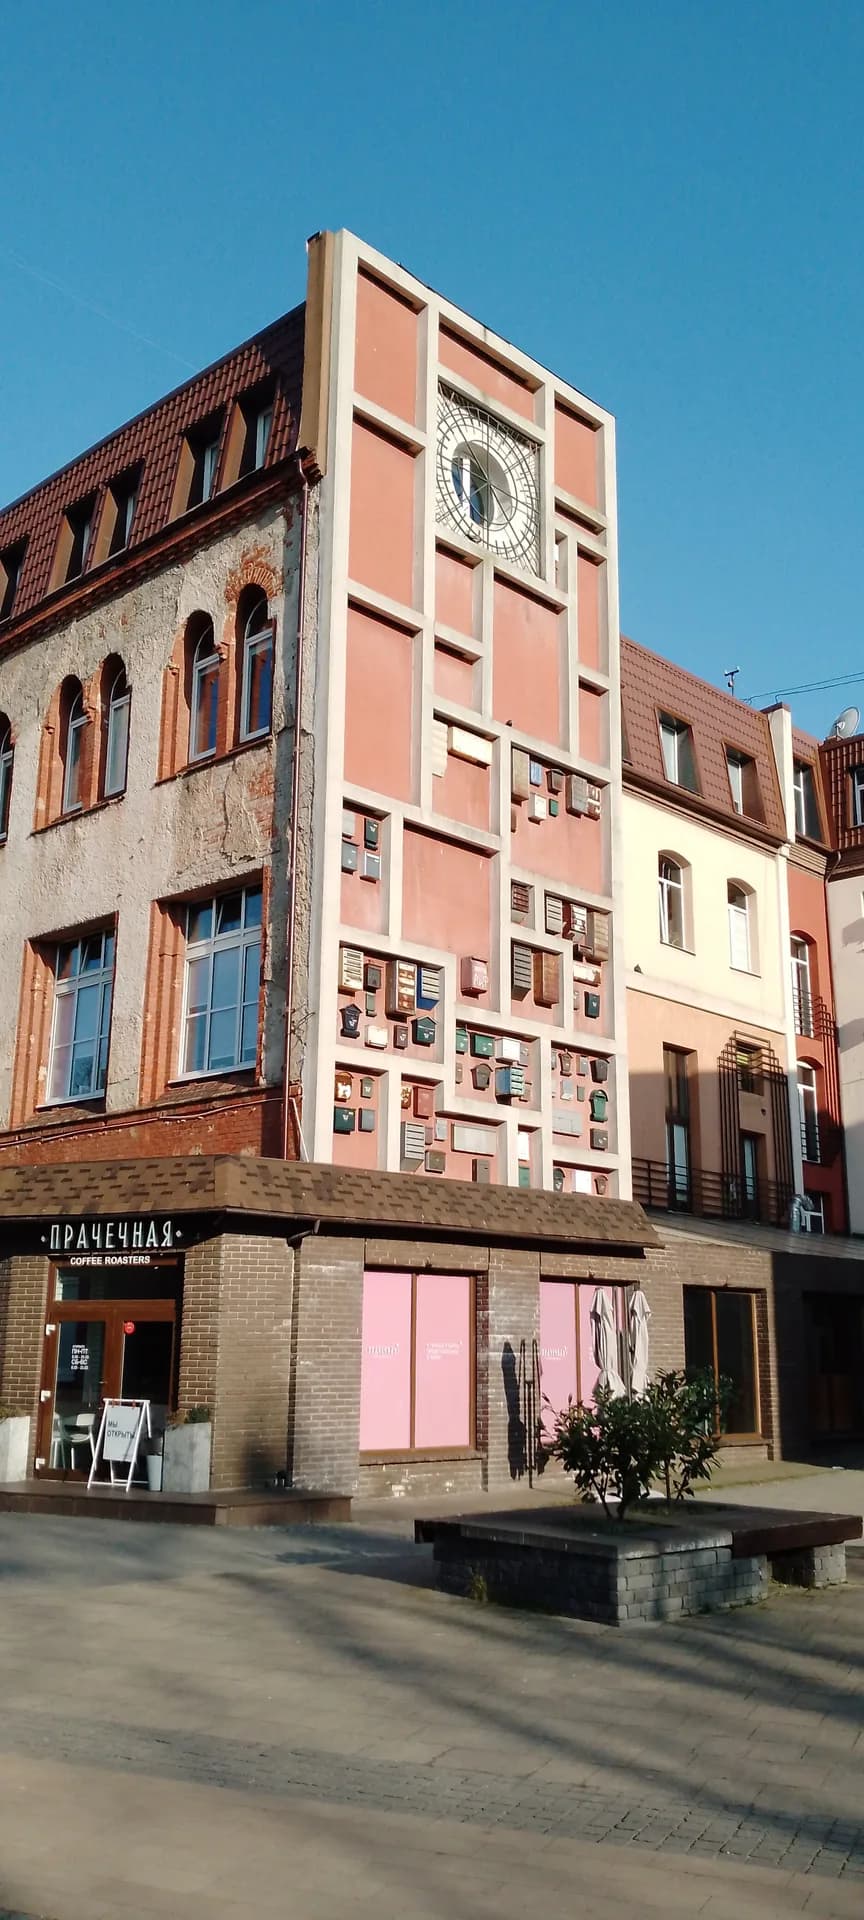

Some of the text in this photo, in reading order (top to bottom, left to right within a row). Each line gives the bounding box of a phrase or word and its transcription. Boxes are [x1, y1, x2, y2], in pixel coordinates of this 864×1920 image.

[50, 1221, 173, 1249] ПРАЧЕЧНАЯ
[70, 1255, 151, 1265] COFFEE ROASTERS
[106, 1429, 136, 1439] ОТКРЫТЫ
